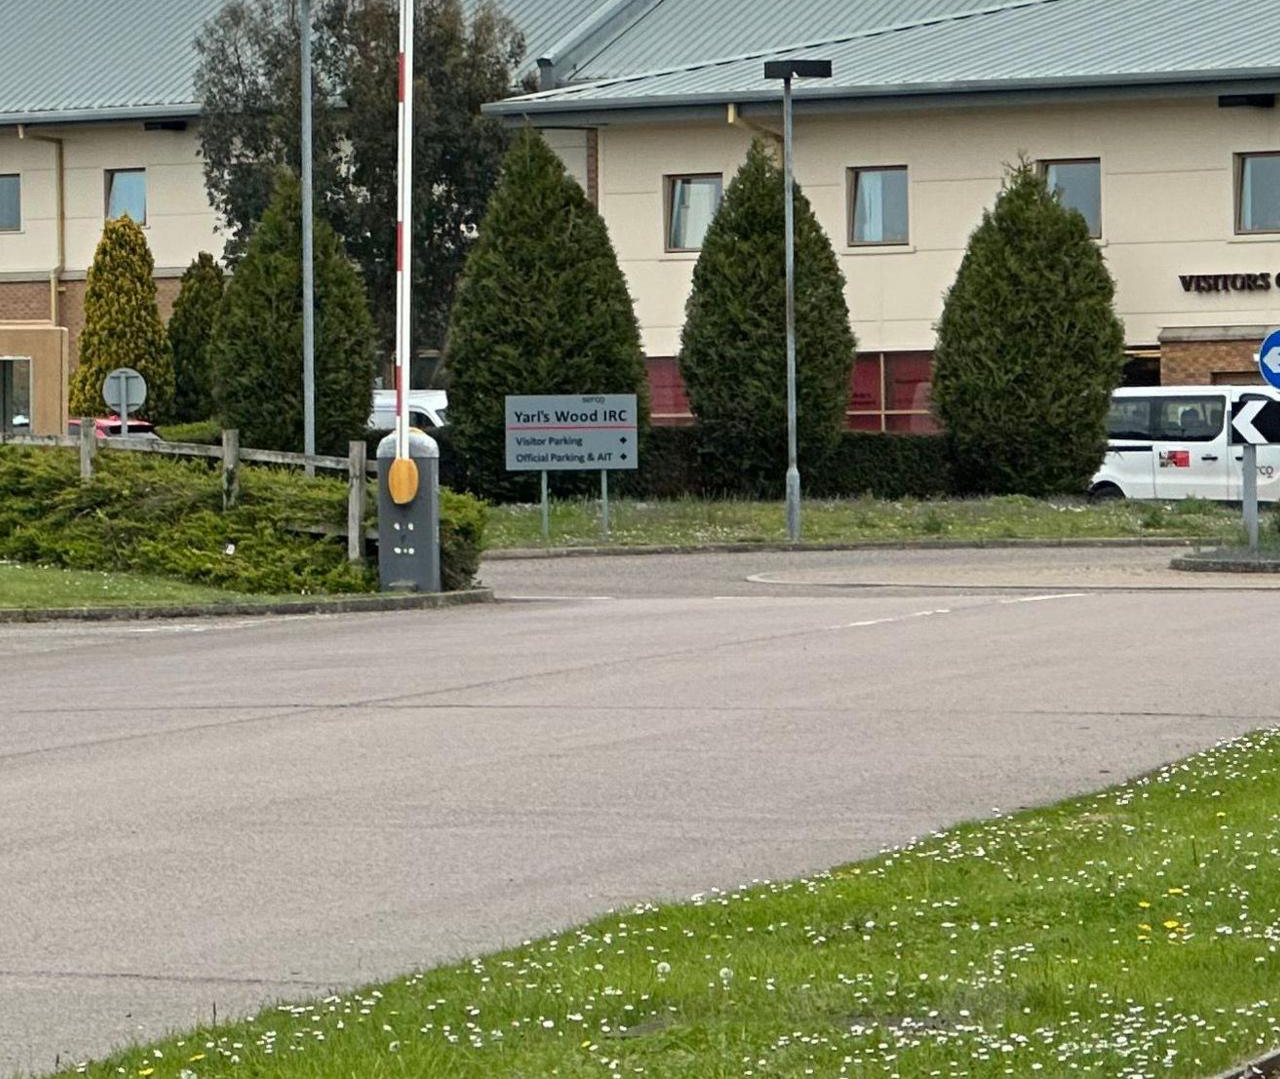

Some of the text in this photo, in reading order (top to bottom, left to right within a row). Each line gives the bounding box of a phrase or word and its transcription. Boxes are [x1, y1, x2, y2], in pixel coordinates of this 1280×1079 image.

[1178, 273, 1271, 293] VISITORS
[514, 410, 627, 423] Yarl's Wood IRC
[515, 436, 583, 447] Visitor Parking
[516, 452, 613, 464] Official Parking & AIT
